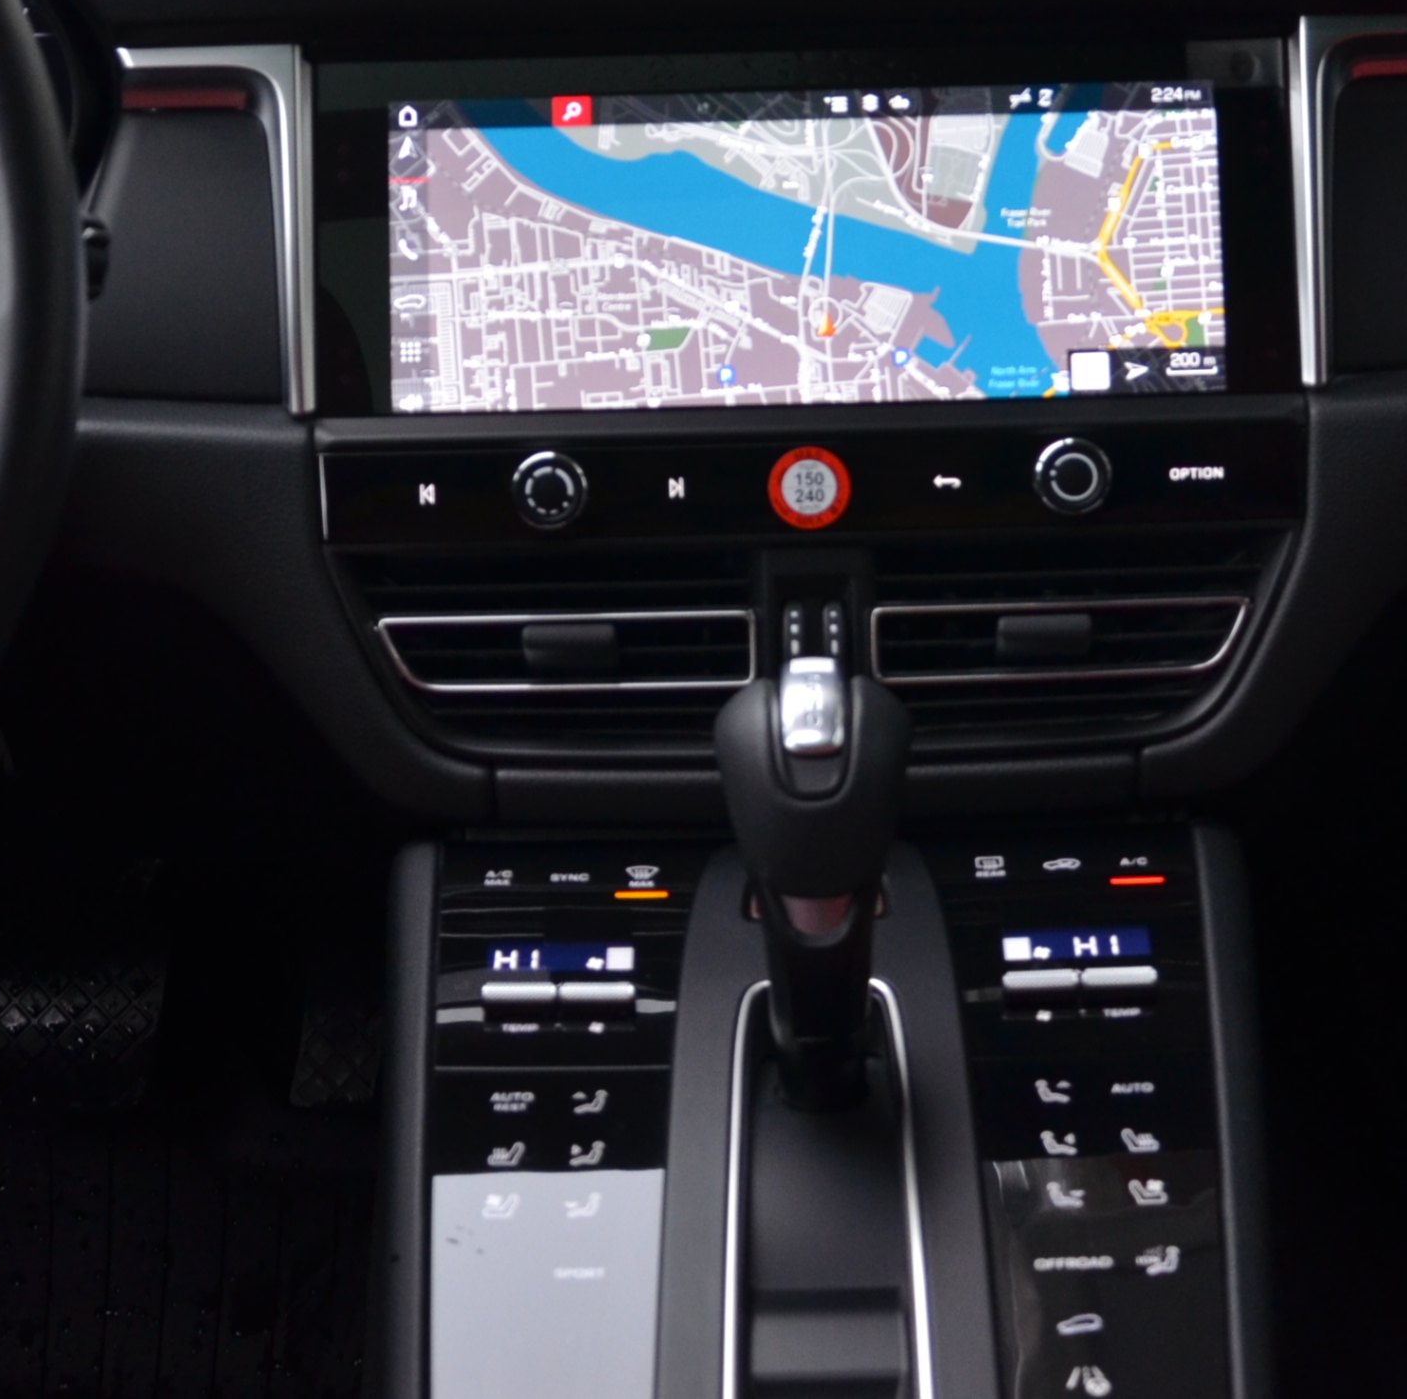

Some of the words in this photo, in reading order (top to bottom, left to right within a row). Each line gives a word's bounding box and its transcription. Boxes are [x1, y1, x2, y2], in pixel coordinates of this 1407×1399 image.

[1170, 353, 1199, 367] 200
[795, 472, 825, 486] 150
[1169, 466, 1224, 481] OPTION
[795, 488, 825, 503] 240
[1119, 856, 1148, 867] A/C
[485, 870, 513, 878] A/C
[549, 873, 590, 882] SYNC
[1111, 1082, 1155, 1094] AUTO
[490, 1091, 535, 1102] AUTO
